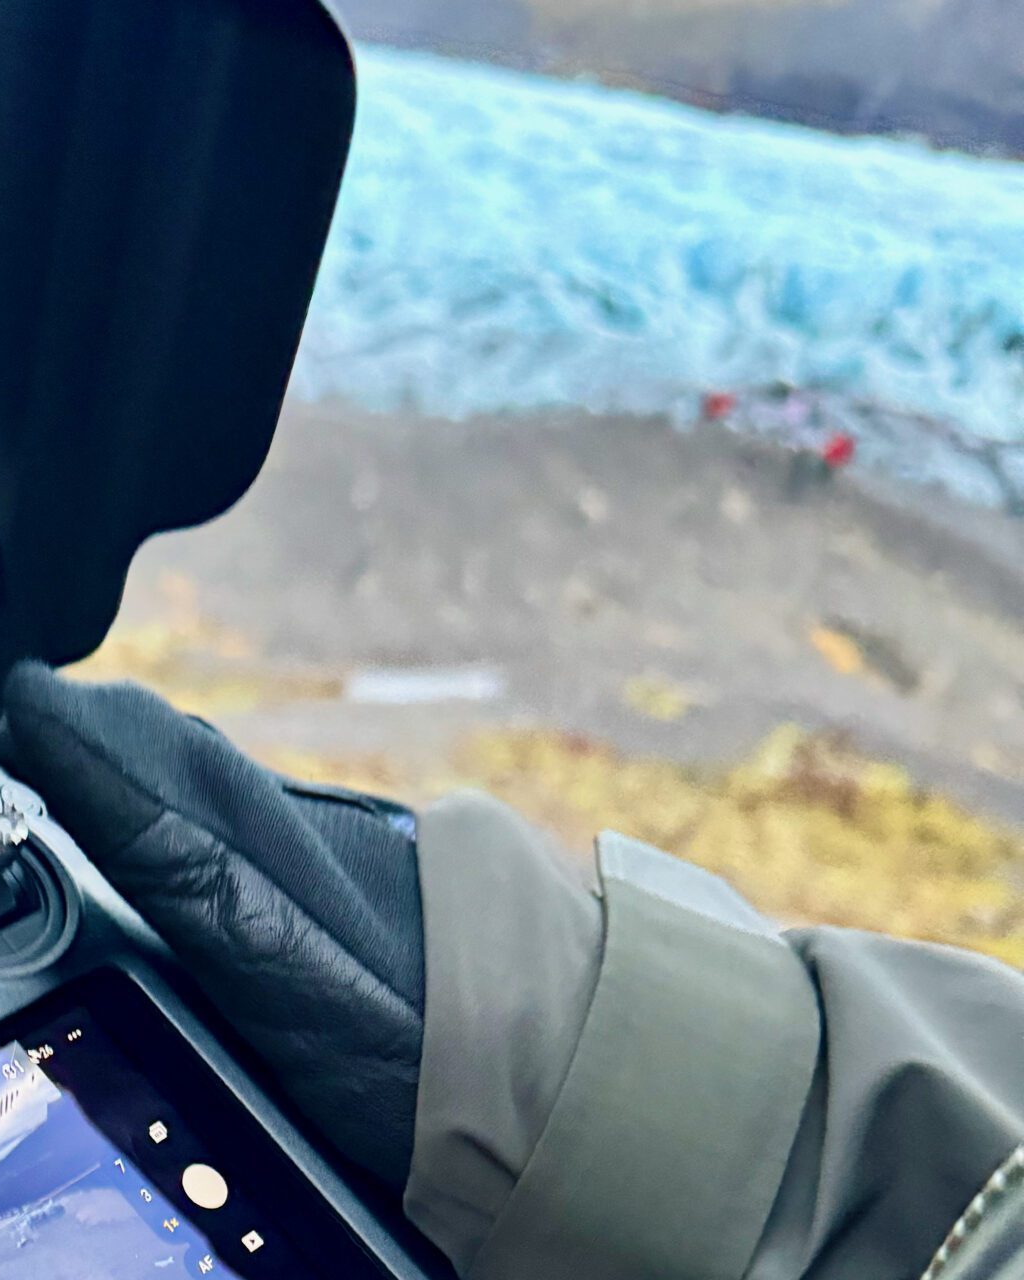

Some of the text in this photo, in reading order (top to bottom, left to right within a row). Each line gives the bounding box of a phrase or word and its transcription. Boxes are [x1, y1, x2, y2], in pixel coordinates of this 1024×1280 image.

[114, 1158, 126, 1174] 7
[140, 1188, 152, 1203] 3
[198, 1254, 214, 1274] AF
